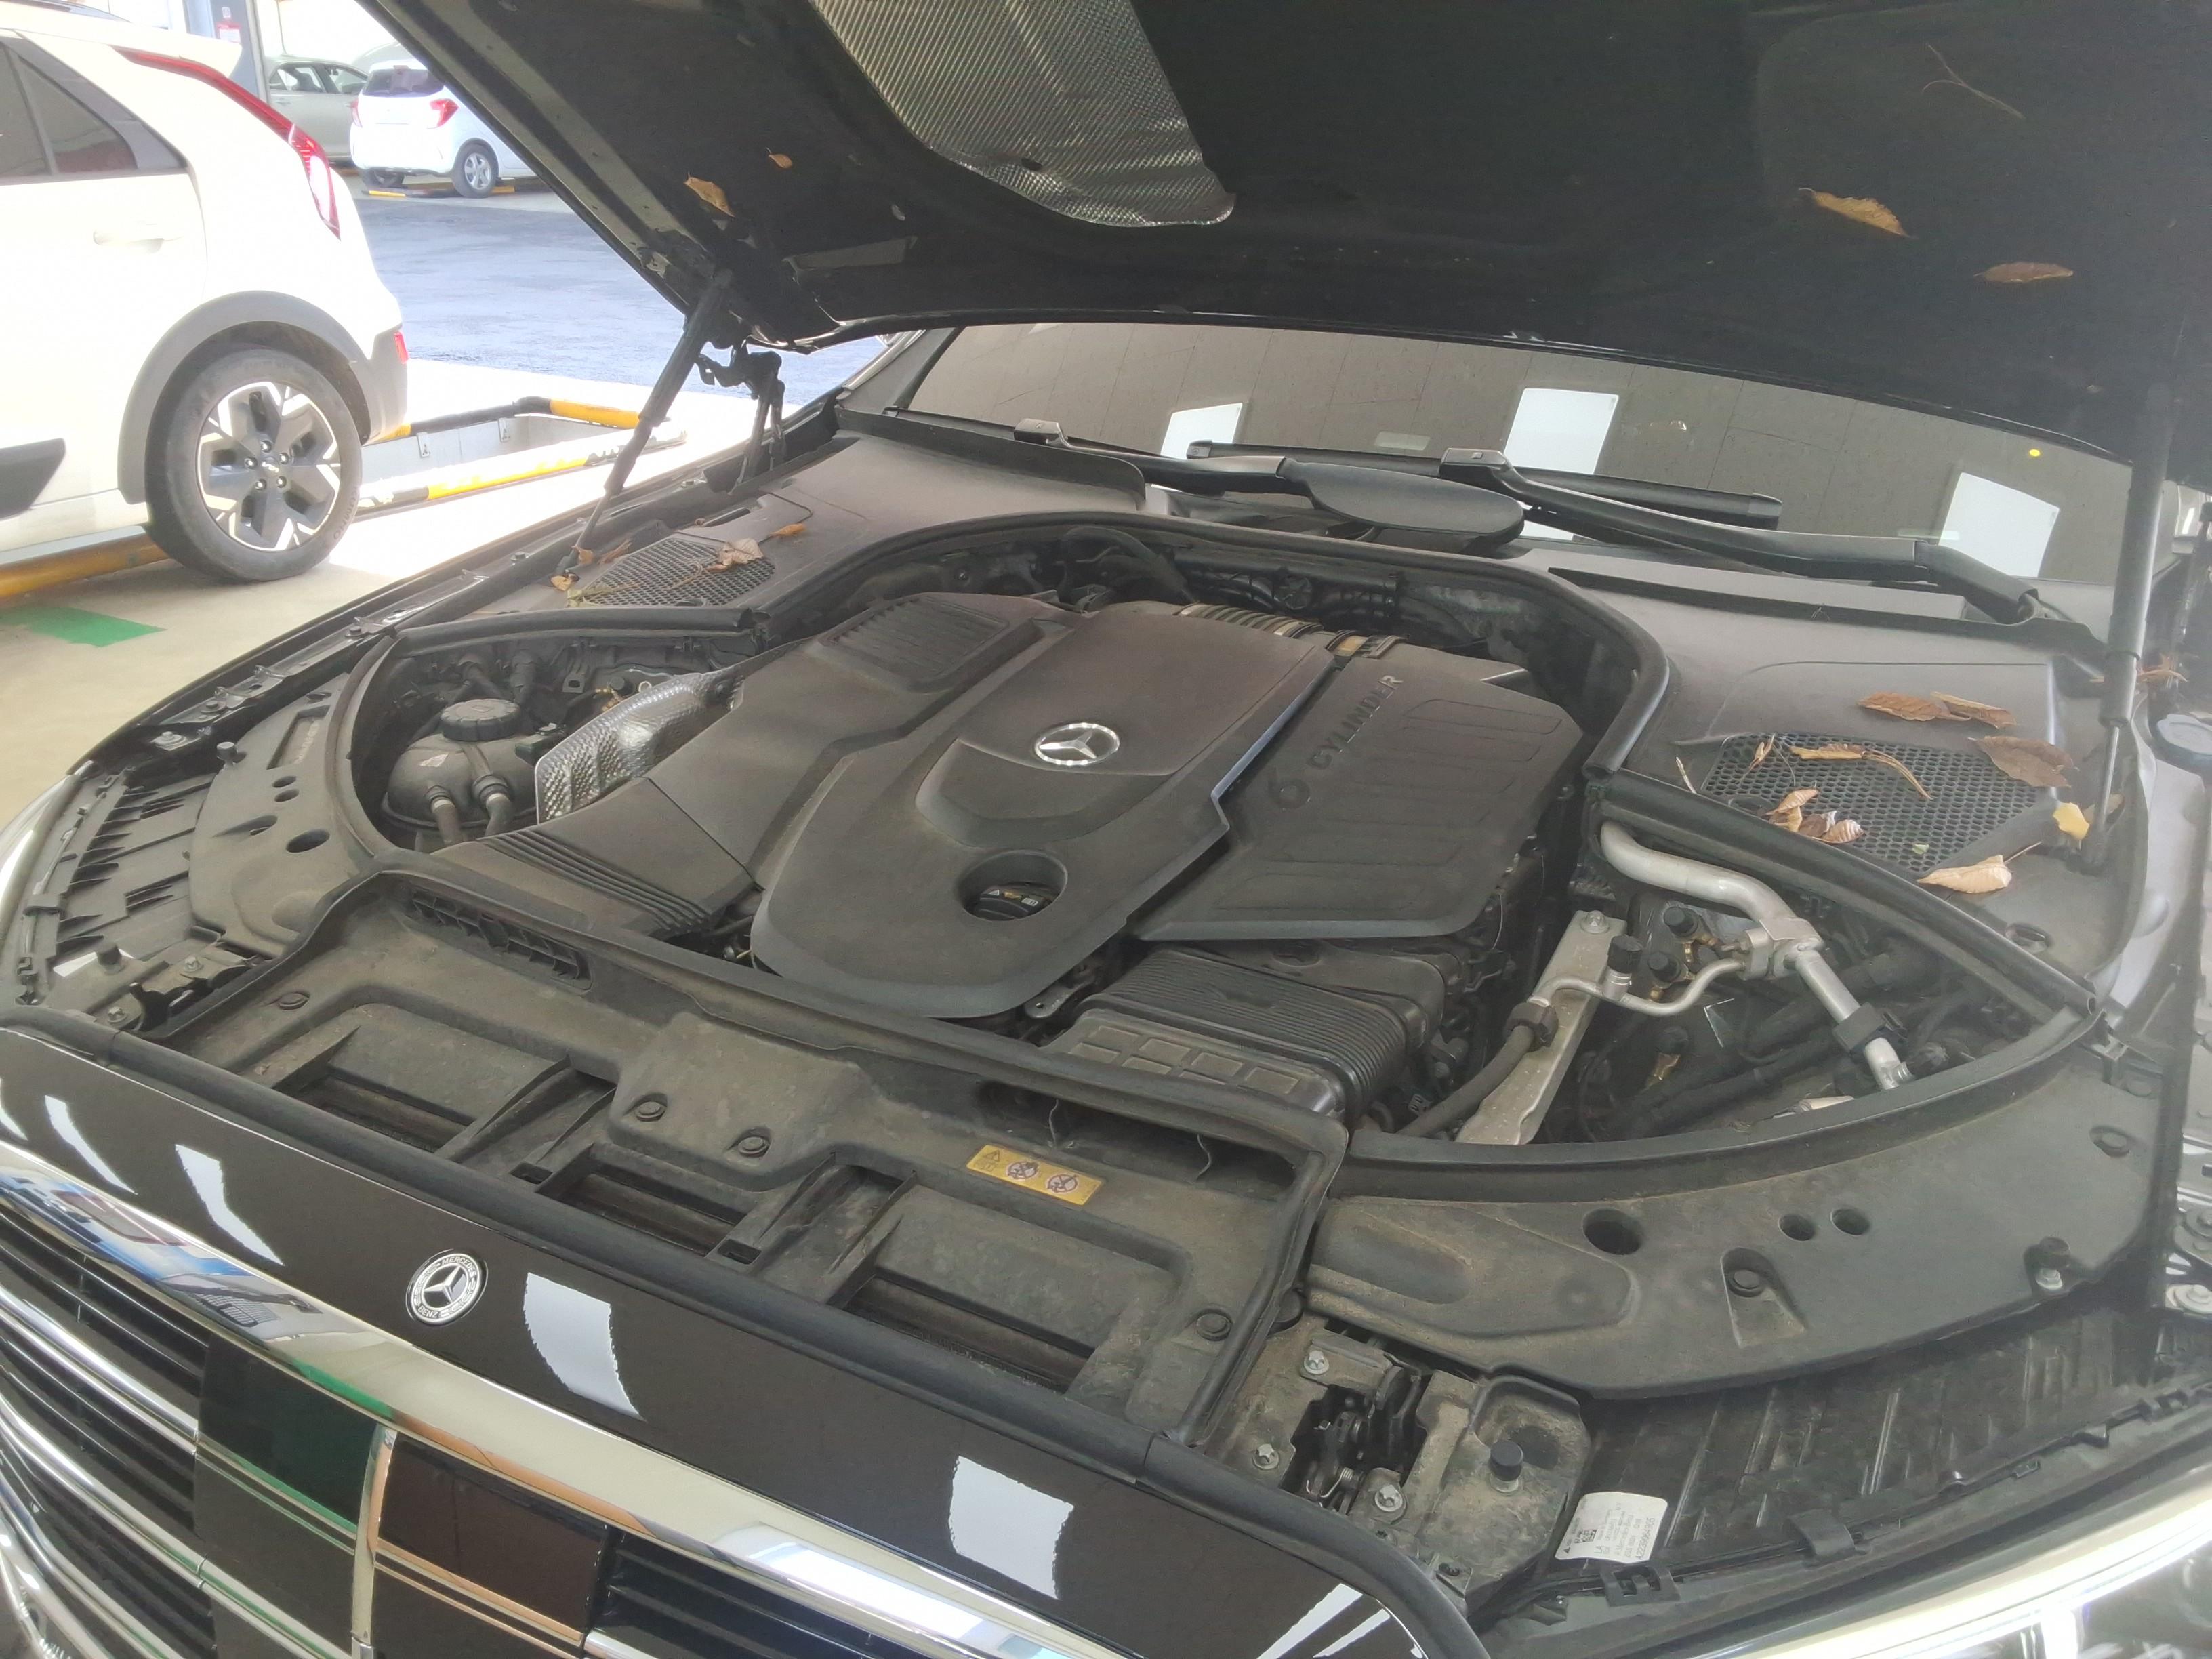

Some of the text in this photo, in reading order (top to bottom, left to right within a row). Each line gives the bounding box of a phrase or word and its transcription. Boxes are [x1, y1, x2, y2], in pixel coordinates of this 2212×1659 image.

[1309, 675, 1403, 769] CYLINDER
[441, 1256, 476, 1277] MERCEDES
[418, 1306, 440, 1319] BENZ
